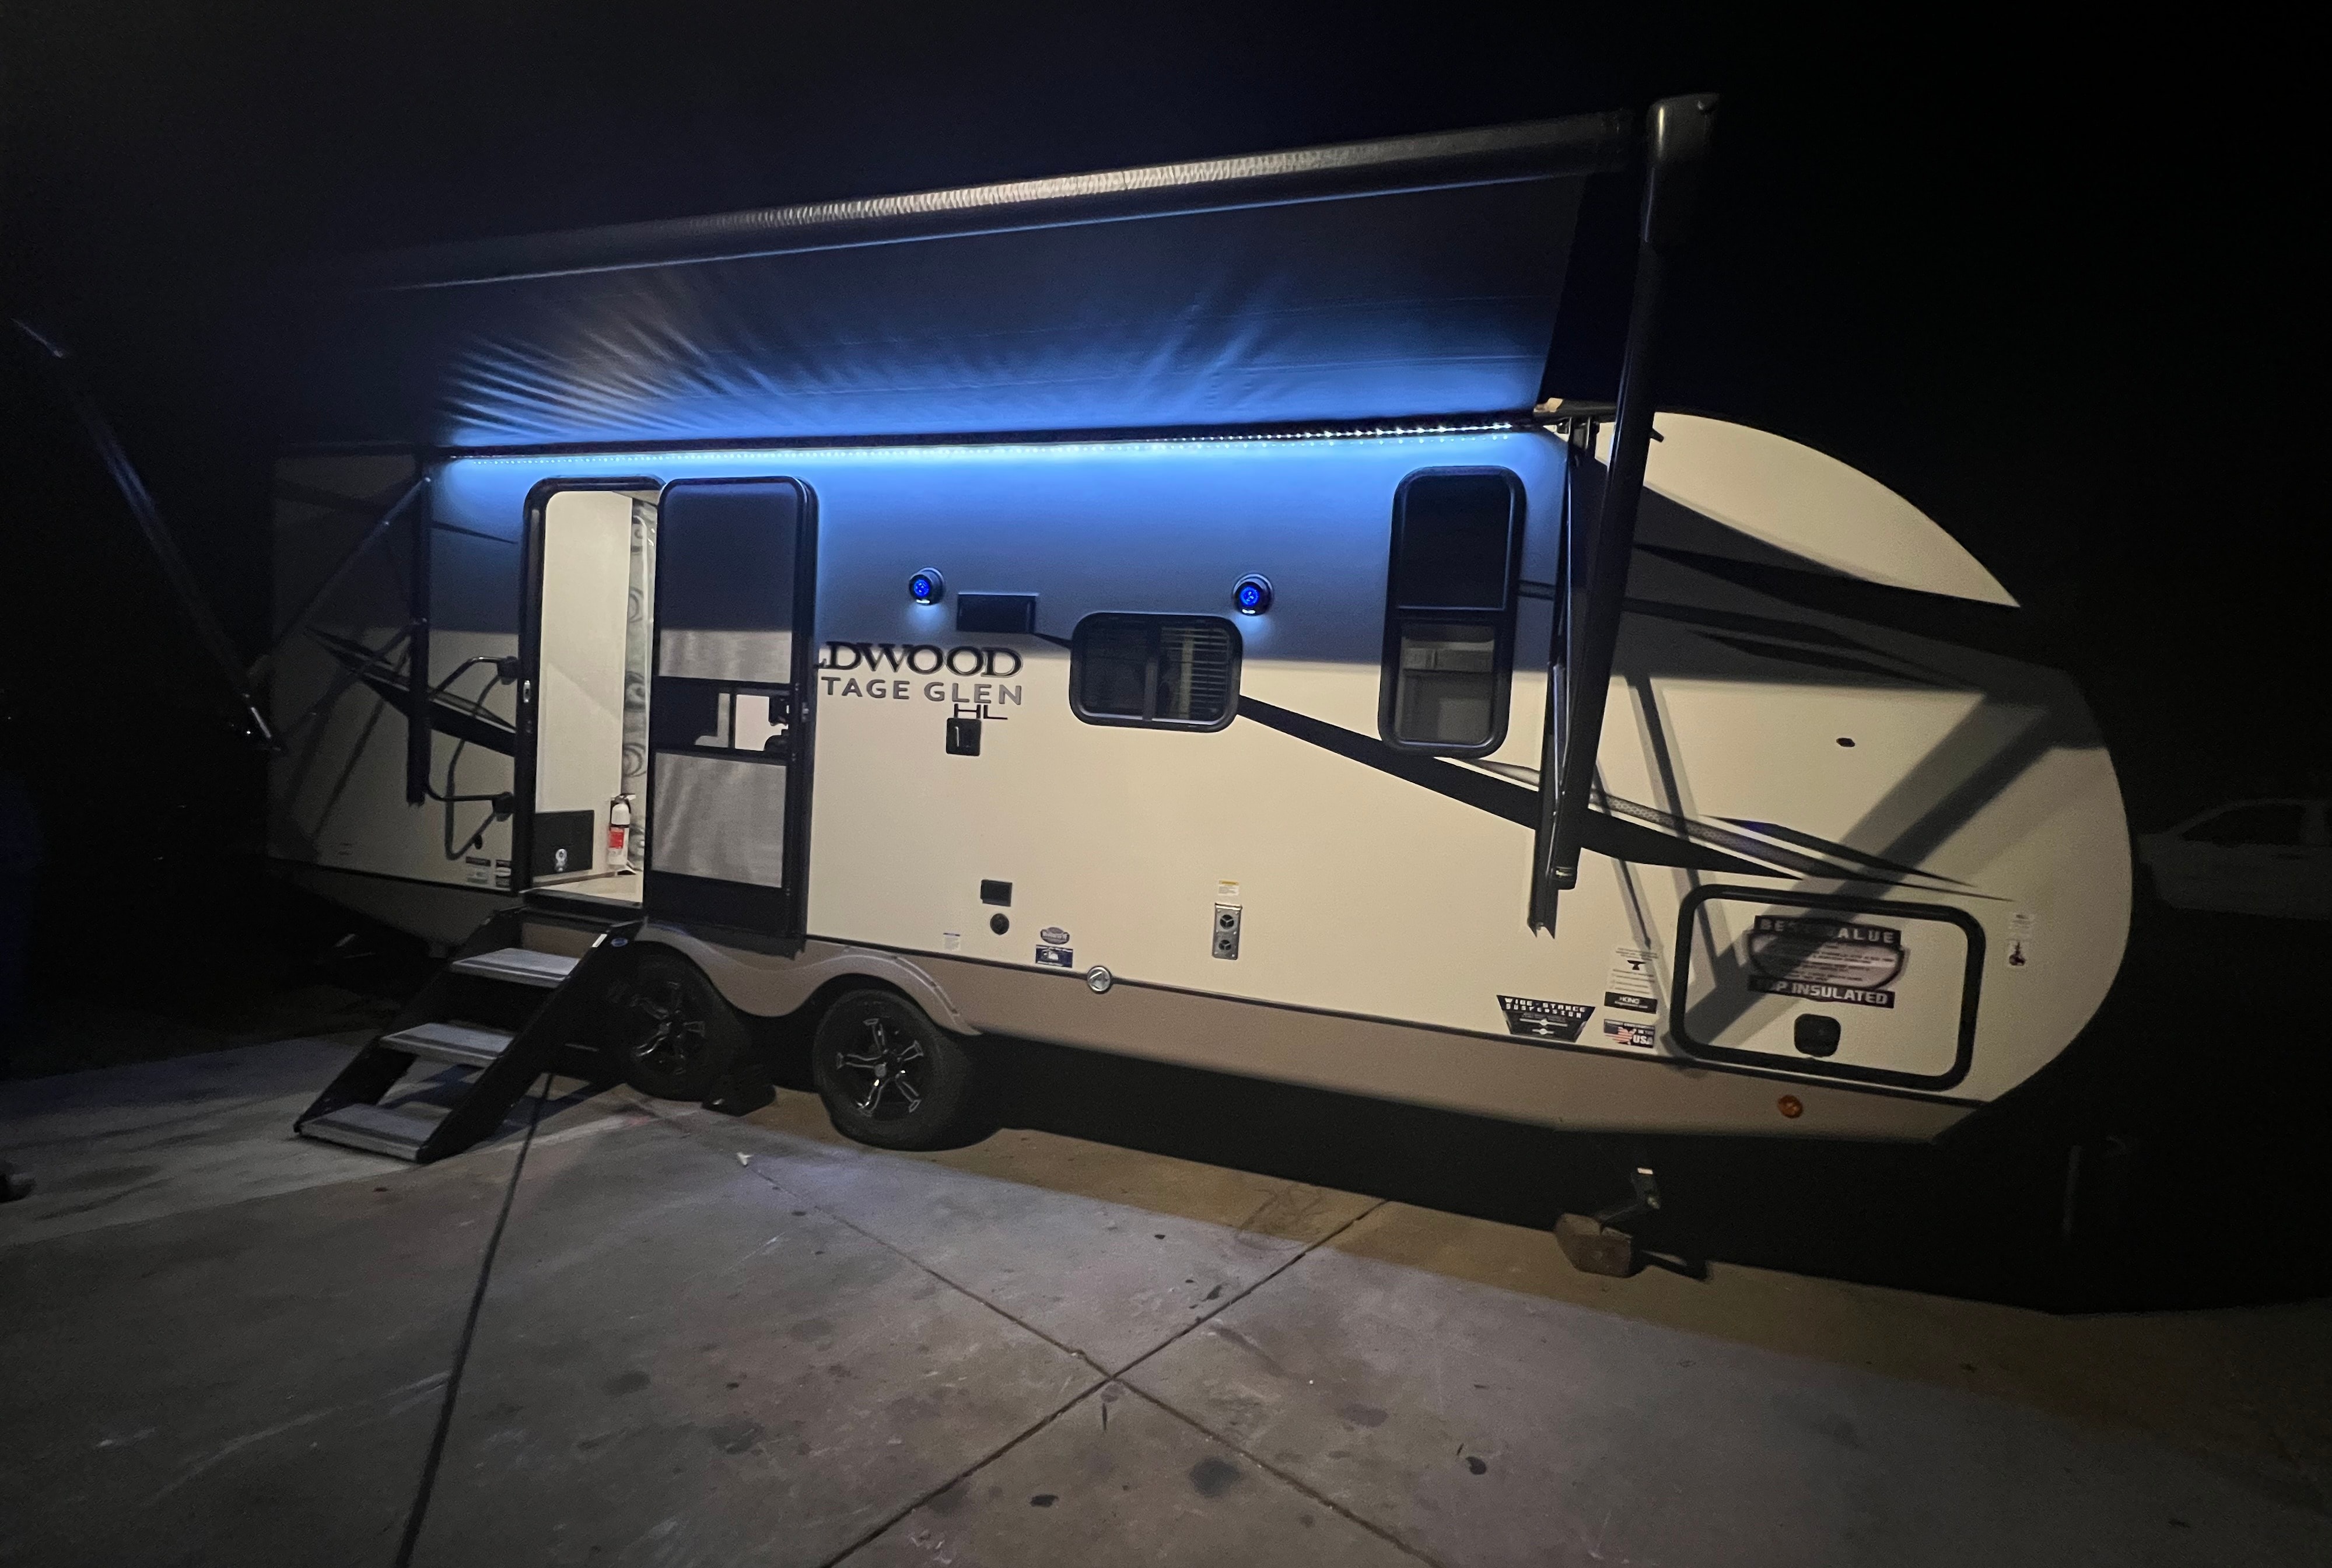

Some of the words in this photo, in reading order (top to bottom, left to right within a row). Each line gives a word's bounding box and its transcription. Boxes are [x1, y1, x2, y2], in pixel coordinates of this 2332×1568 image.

[821, 677, 910, 700] TAGE
[924, 681, 1022, 705] GLEN
[954, 703, 1008, 720] HL
[1830, 927, 1895, 943] ALUE
[1791, 983, 1888, 1004] INSULATED
[1633, 1034, 1653, 1045] USA
